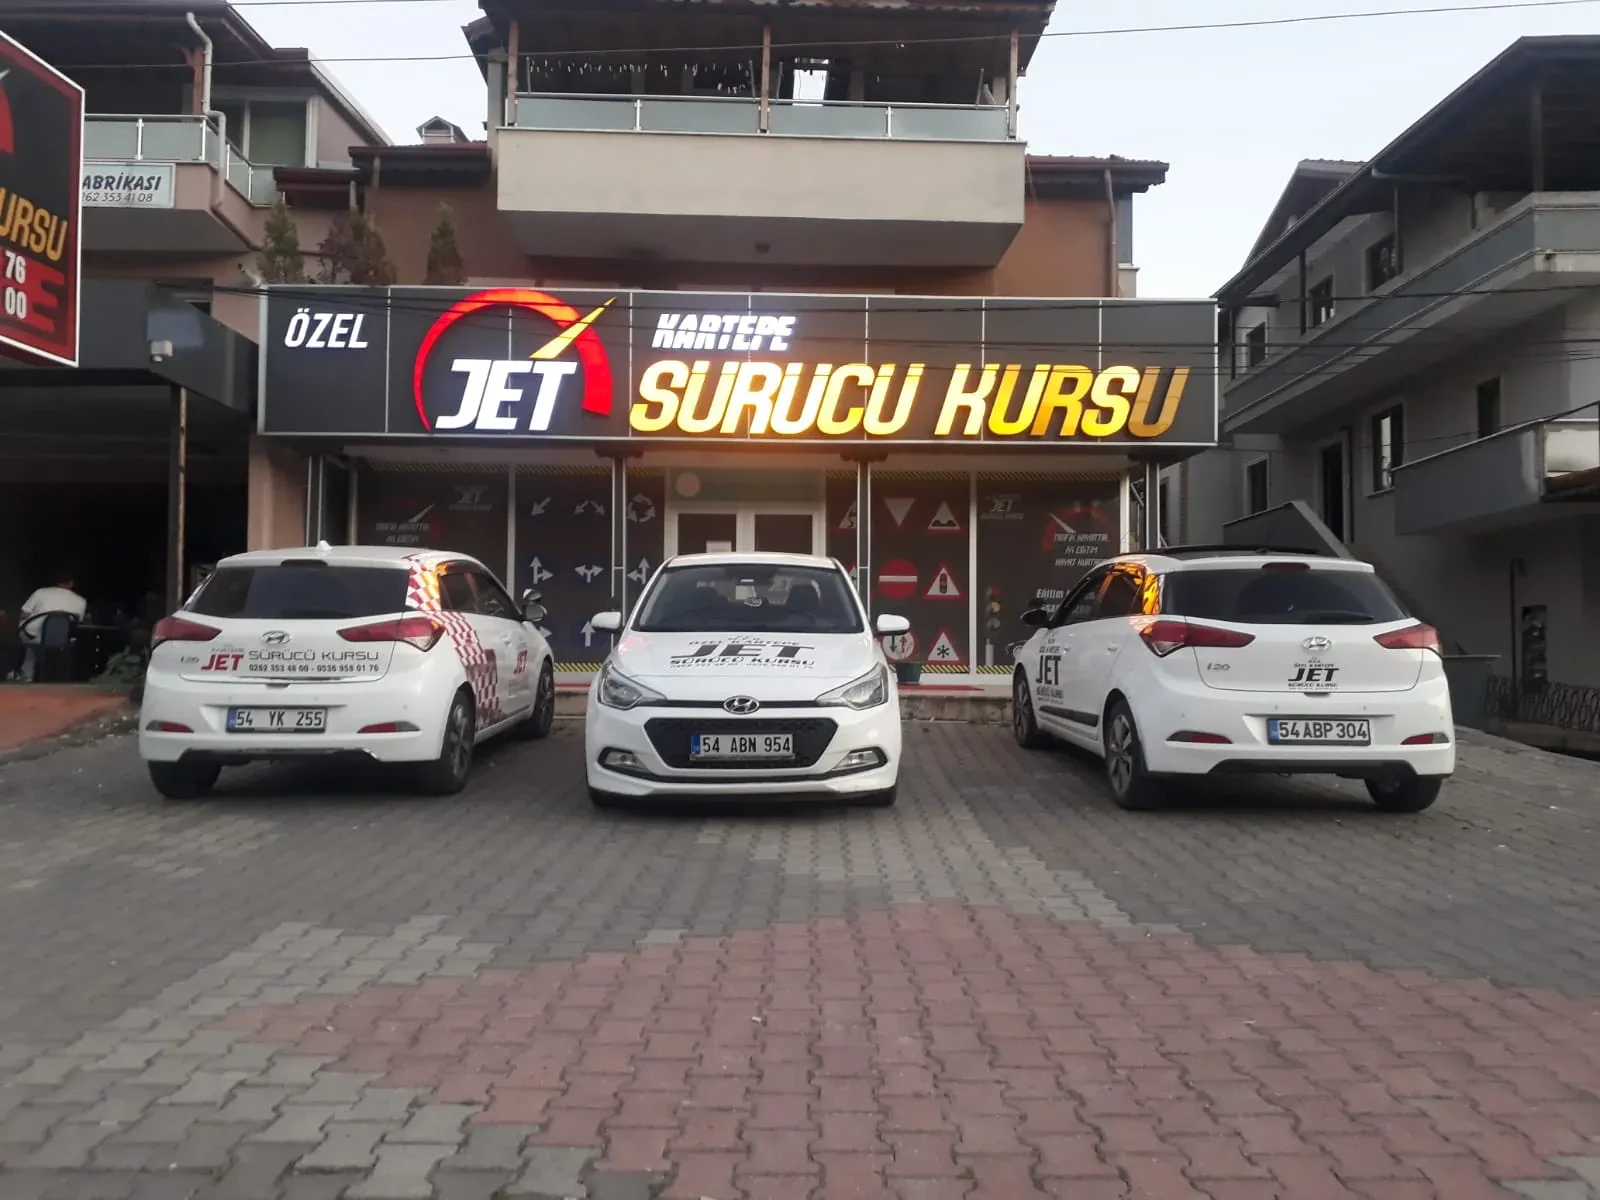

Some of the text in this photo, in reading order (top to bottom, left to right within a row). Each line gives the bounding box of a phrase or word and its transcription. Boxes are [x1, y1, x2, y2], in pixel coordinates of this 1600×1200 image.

[102, 192, 122, 202] 353
[138, 192, 154, 203] 08
[5, 250, 26, 284] 76
[5, 286, 27, 320] 00
[284, 307, 368, 348] ÖZEL
[651, 313, 797, 351] KARTEPE
[435, 358, 578, 431] JET
[934, 363, 1191, 438] KURSU
[248, 649, 316, 661] SÜRÜCÜ
[321, 650, 379, 661] KURSU
[670, 643, 816, 659] JET
[200, 653, 245, 671] JET
[1036, 655, 1062, 686] JET
[1287, 667, 1340, 682] JET
[236, 711, 253, 726] 54
[269, 711, 286, 726] YK
[295, 711, 322, 727] 255
[1279, 721, 1367, 739] 54 ABP 304
[702, 736, 720, 753] 54
[730, 736, 757, 753] ABN
[764, 736, 791, 753] 954
